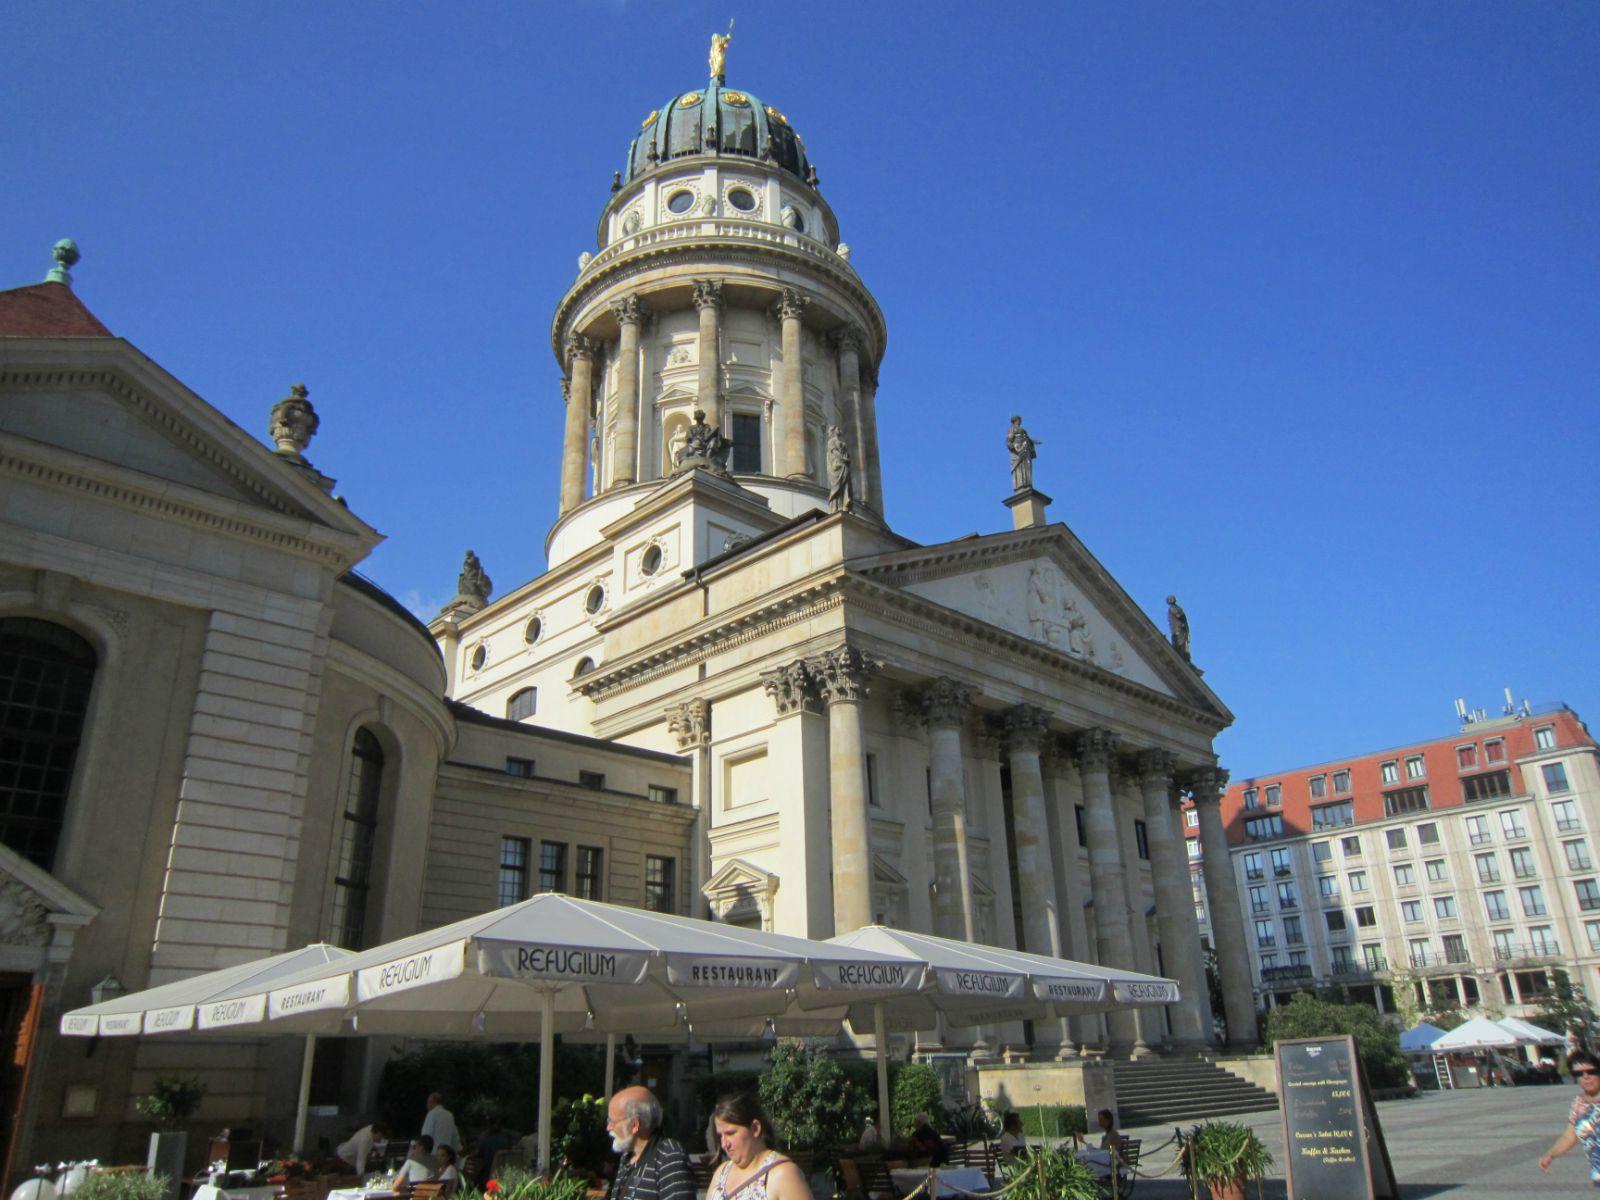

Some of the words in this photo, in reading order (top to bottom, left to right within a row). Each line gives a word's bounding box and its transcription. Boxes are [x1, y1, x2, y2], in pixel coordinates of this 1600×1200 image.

[379, 955, 433, 989] REFUGIUM
[518, 947, 616, 976] REFUGIUM
[692, 965, 779, 982] RESTAURANT
[838, 965, 904, 985] REFUGIUM
[956, 973, 1010, 994] REFUGIUM
[281, 989, 326, 1010] RESTAURANT
[1048, 984, 1096, 998] RESTAURANT
[212, 1001, 248, 1023] REFUGIUM
